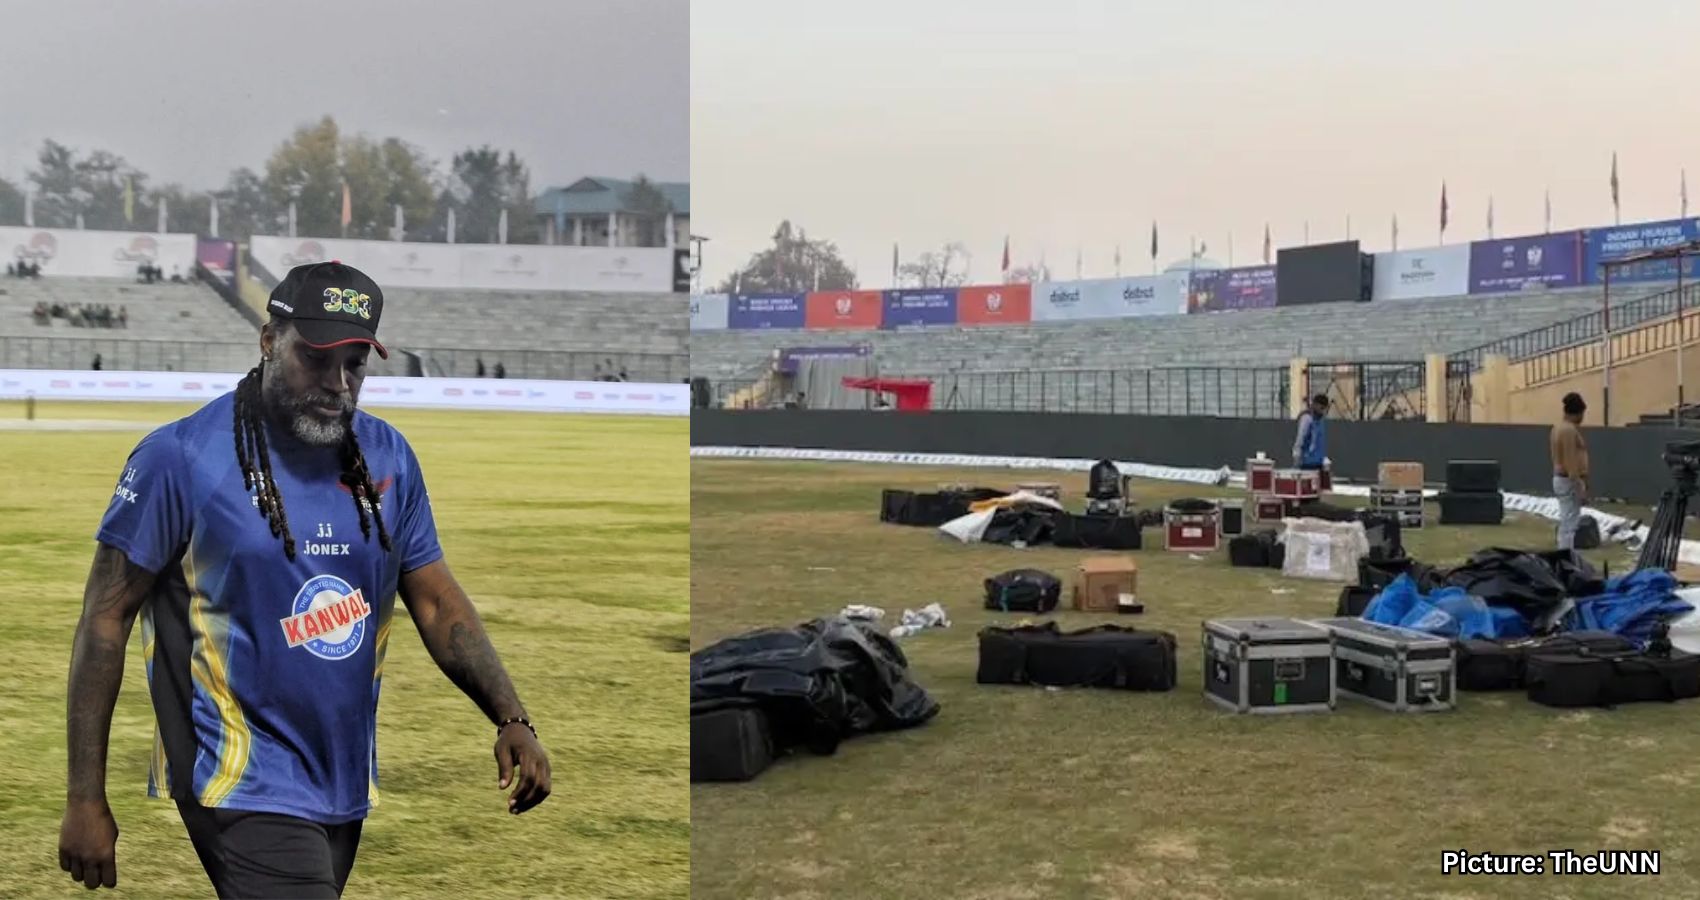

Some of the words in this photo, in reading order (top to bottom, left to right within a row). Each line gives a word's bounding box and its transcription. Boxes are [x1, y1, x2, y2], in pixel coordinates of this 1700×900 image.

[323, 287, 372, 320] 333
[115, 485, 138, 503] ONEX
[284, 592, 369, 643] KANWAL
[321, 645, 347, 655] SINCE
